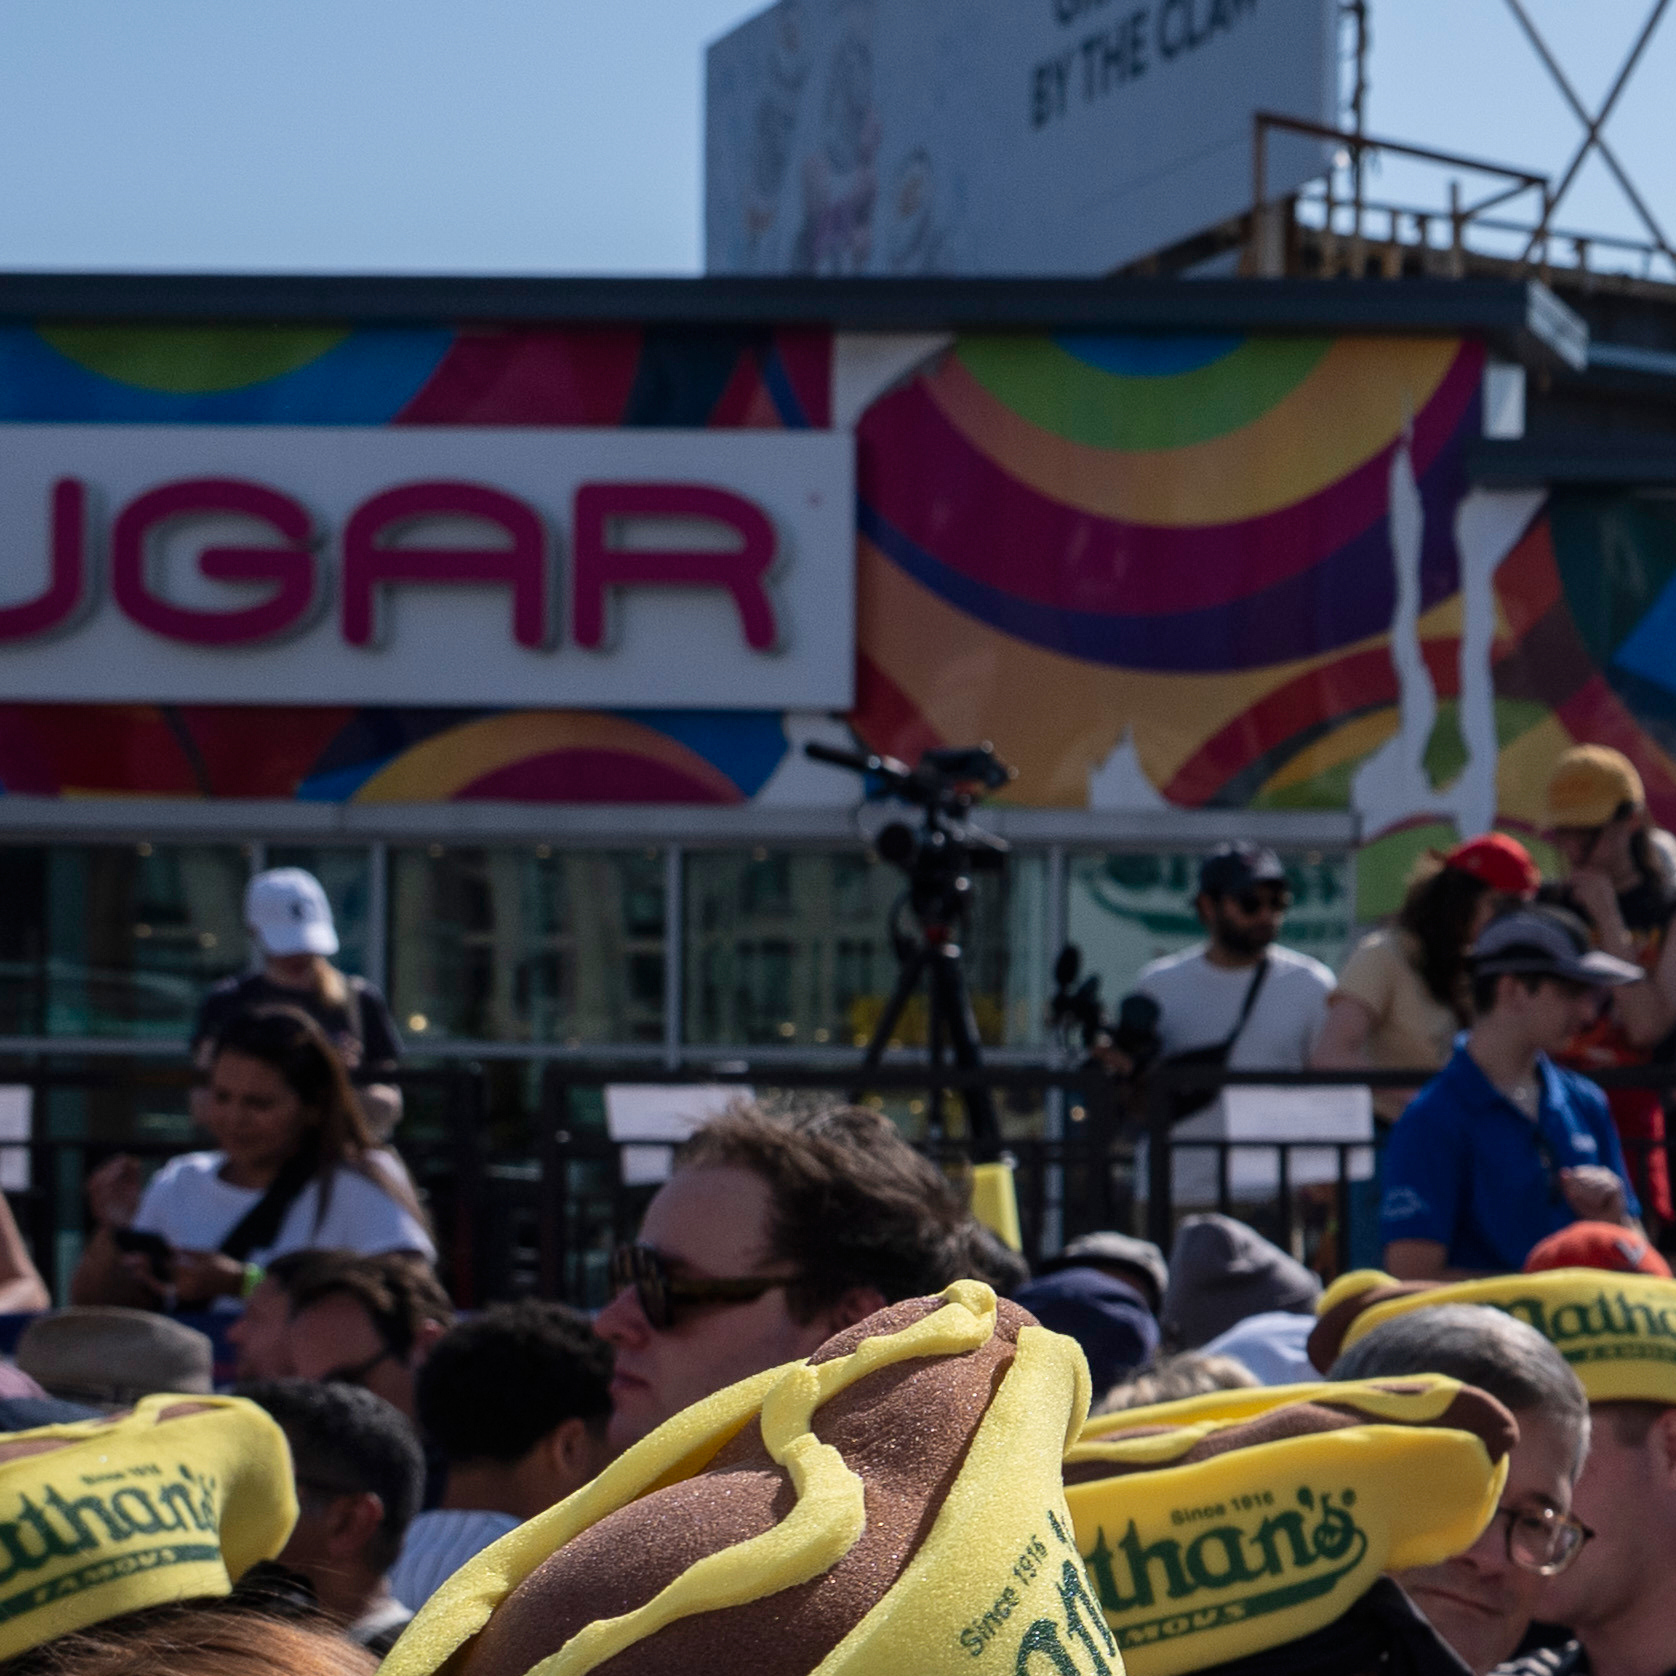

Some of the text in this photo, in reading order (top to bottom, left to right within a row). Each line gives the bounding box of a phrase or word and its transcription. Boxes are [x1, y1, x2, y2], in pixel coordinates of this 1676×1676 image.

[1082, 8, 1147, 100] THE
[1171, 1491, 1275, 1525] Since 1916
[959, 1534, 1049, 1658] Since 1916
